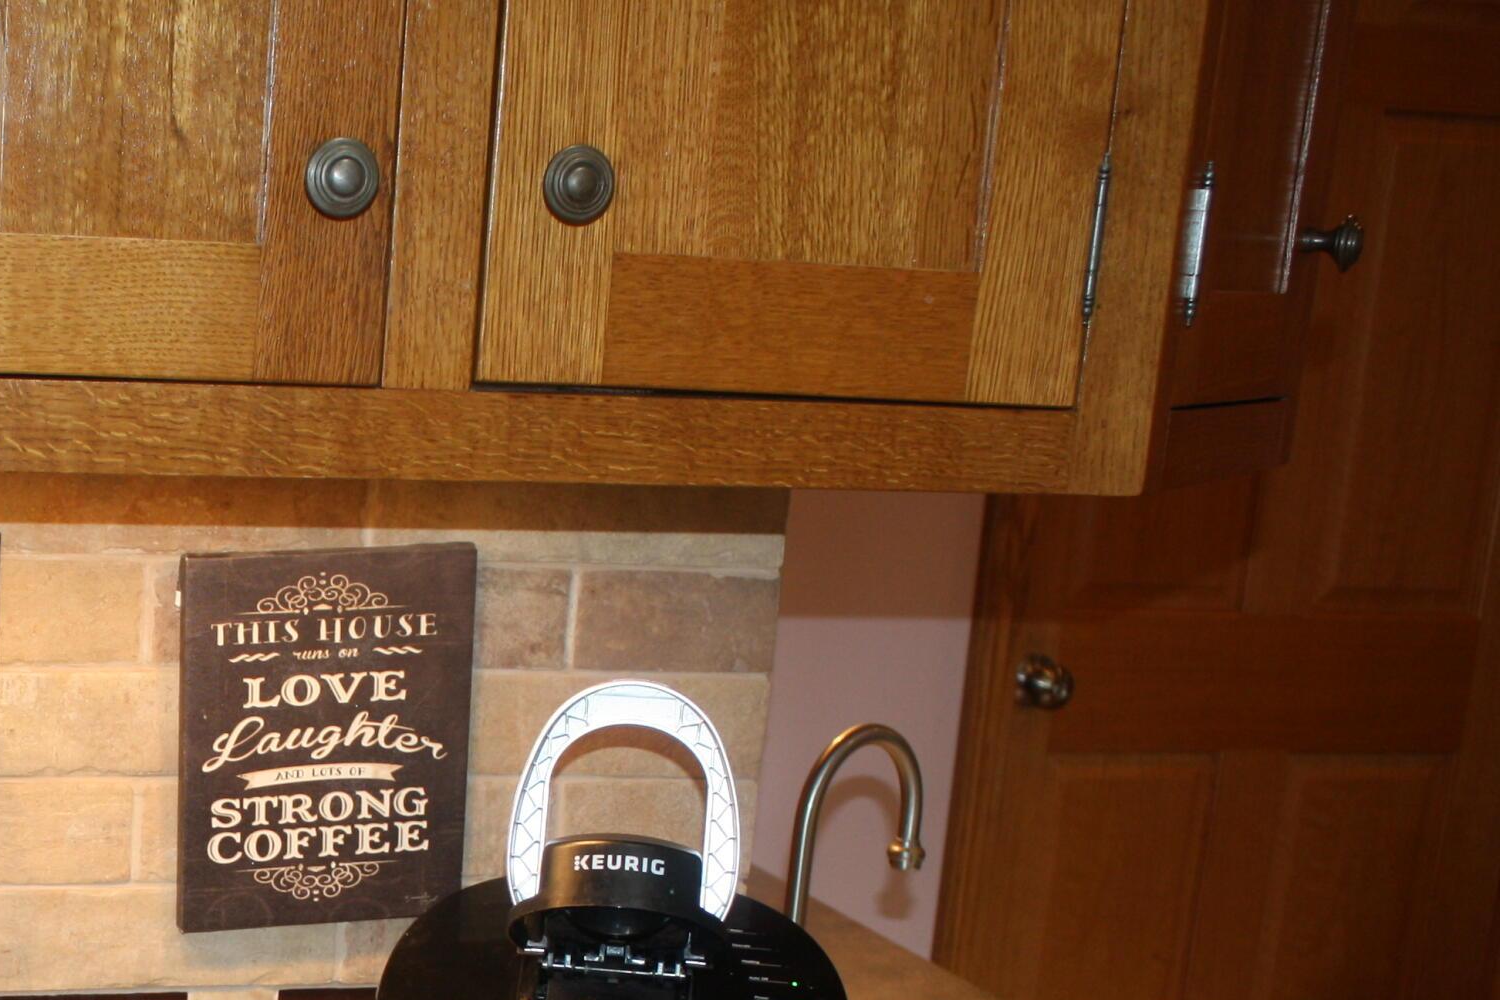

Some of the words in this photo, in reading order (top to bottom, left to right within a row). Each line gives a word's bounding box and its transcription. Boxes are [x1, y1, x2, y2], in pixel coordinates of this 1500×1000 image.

[211, 617, 299, 646] THIS
[316, 612, 438, 643] HOUSE
[293, 647, 330, 660] runs
[338, 646, 359, 658] on
[242, 670, 407, 709] LOVE
[202, 711, 448, 773] Laughter
[275, 770, 304, 781] AND
[311, 767, 342, 777] LOTS
[350, 766, 366, 776] OF
[211, 787, 429, 829] STRONG
[207, 820, 429, 864] COFFEE
[574, 854, 665, 876] KEURIG
